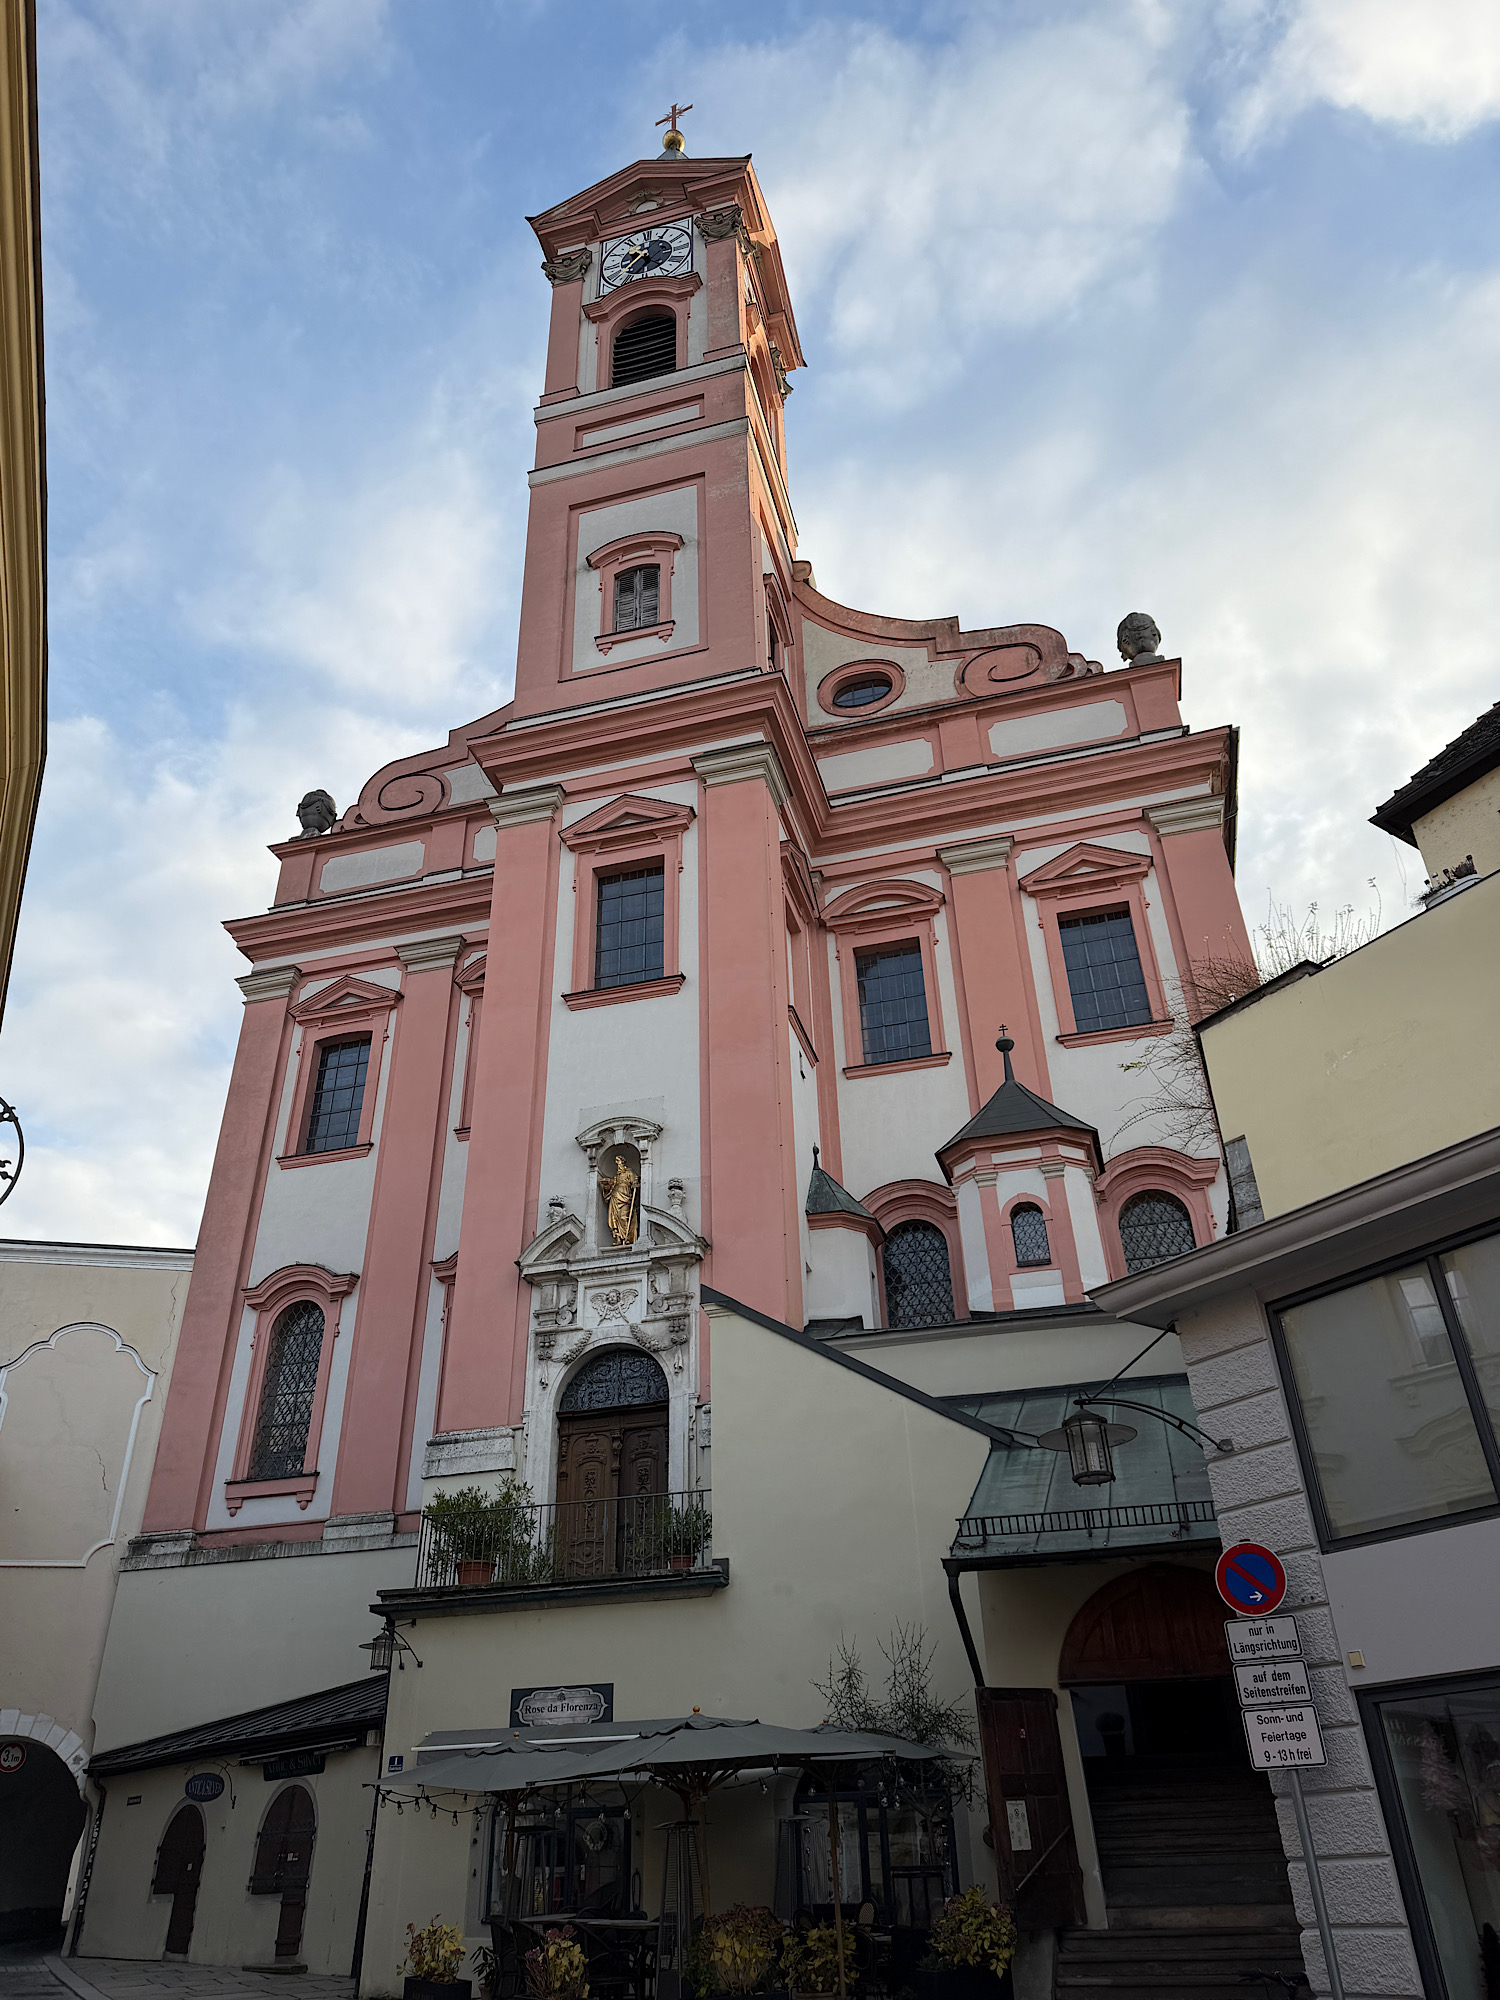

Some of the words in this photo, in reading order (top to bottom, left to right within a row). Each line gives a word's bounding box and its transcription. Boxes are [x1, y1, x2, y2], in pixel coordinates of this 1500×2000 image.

[1248, 1626, 1263, 1637] nur
[1265, 1623, 1275, 1635] in
[1233, 1637, 1298, 1655] Längsrichtung
[1252, 1670, 1267, 1683] auf
[1271, 1669, 1291, 1681] dem
[1243, 1683, 1307, 1698] Seitenstreifen
[525, 1704, 545, 1714] Rose
[547, 1703, 558, 1713] da
[560, 1702, 598, 1712] Florenza
[1256, 1714, 1284, 1725] Sonn-
[1285, 1711, 1304, 1723] und
[1260, 1730, 1307, 1743] Feiertage
[1263, 1750, 1271, 1763] 9
[1277, 1749, 1288, 1762] 13
[1288, 1748, 1296, 1761] h
[1296, 1747, 1312, 1761] frei
